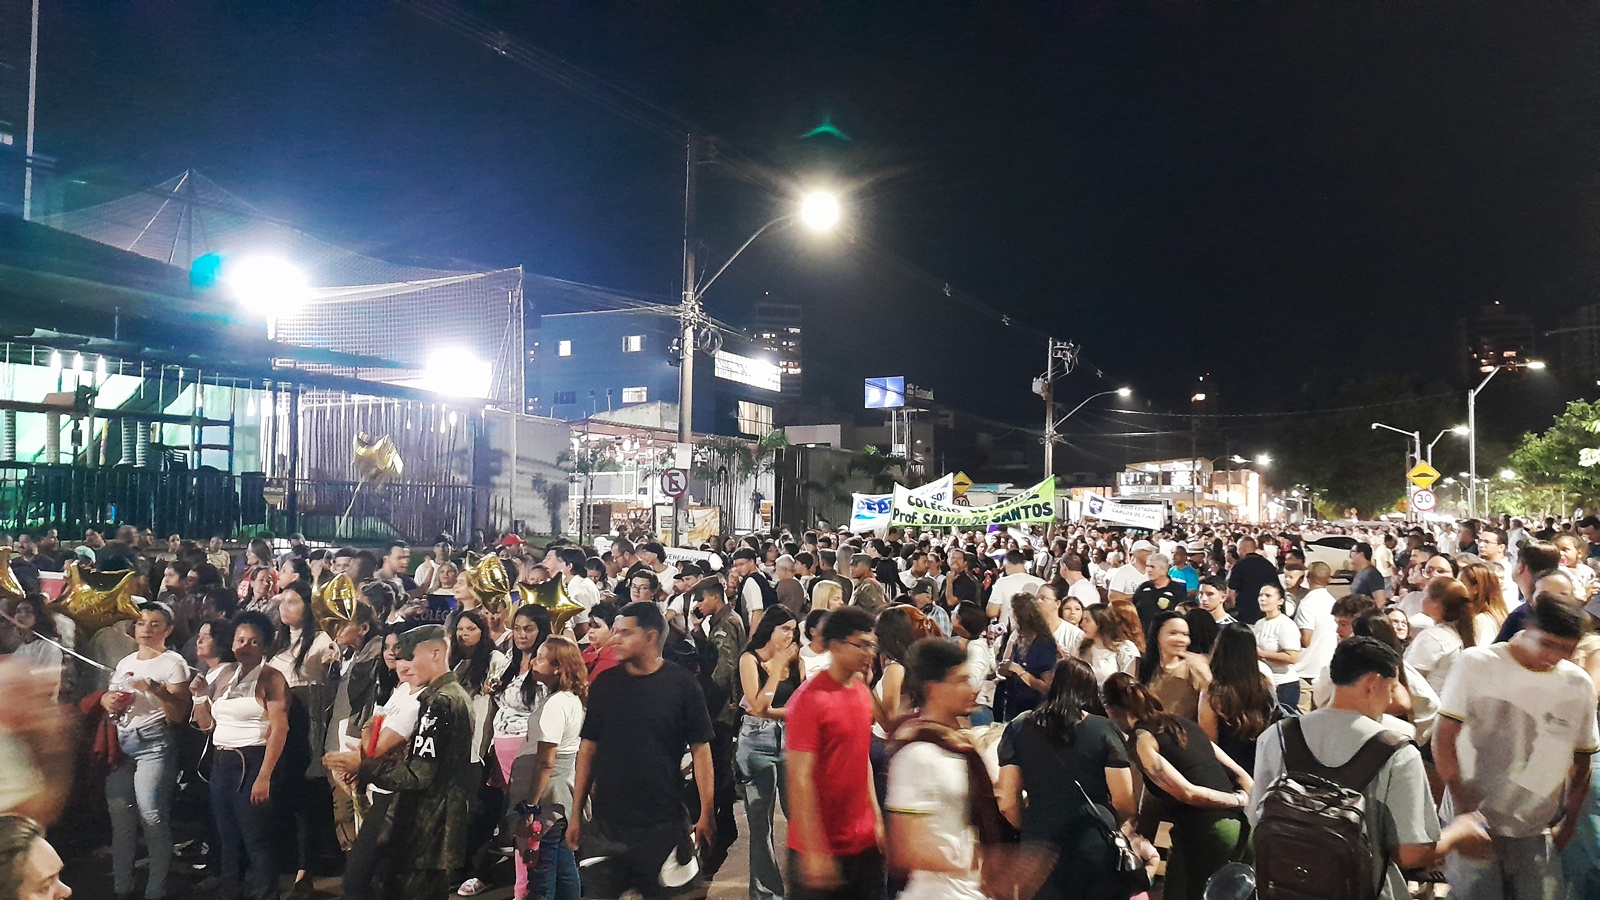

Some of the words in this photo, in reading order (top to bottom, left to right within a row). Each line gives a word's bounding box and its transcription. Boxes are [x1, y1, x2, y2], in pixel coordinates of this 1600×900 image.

[907, 495, 961, 513] COLÉGIO
[1417, 494, 1431, 503] 30
[892, 507, 918, 524] Prof.
[922, 513, 989, 525] SALVADOR
[991, 501, 1053, 523] SANTOS
[413, 735, 436, 758] PA
